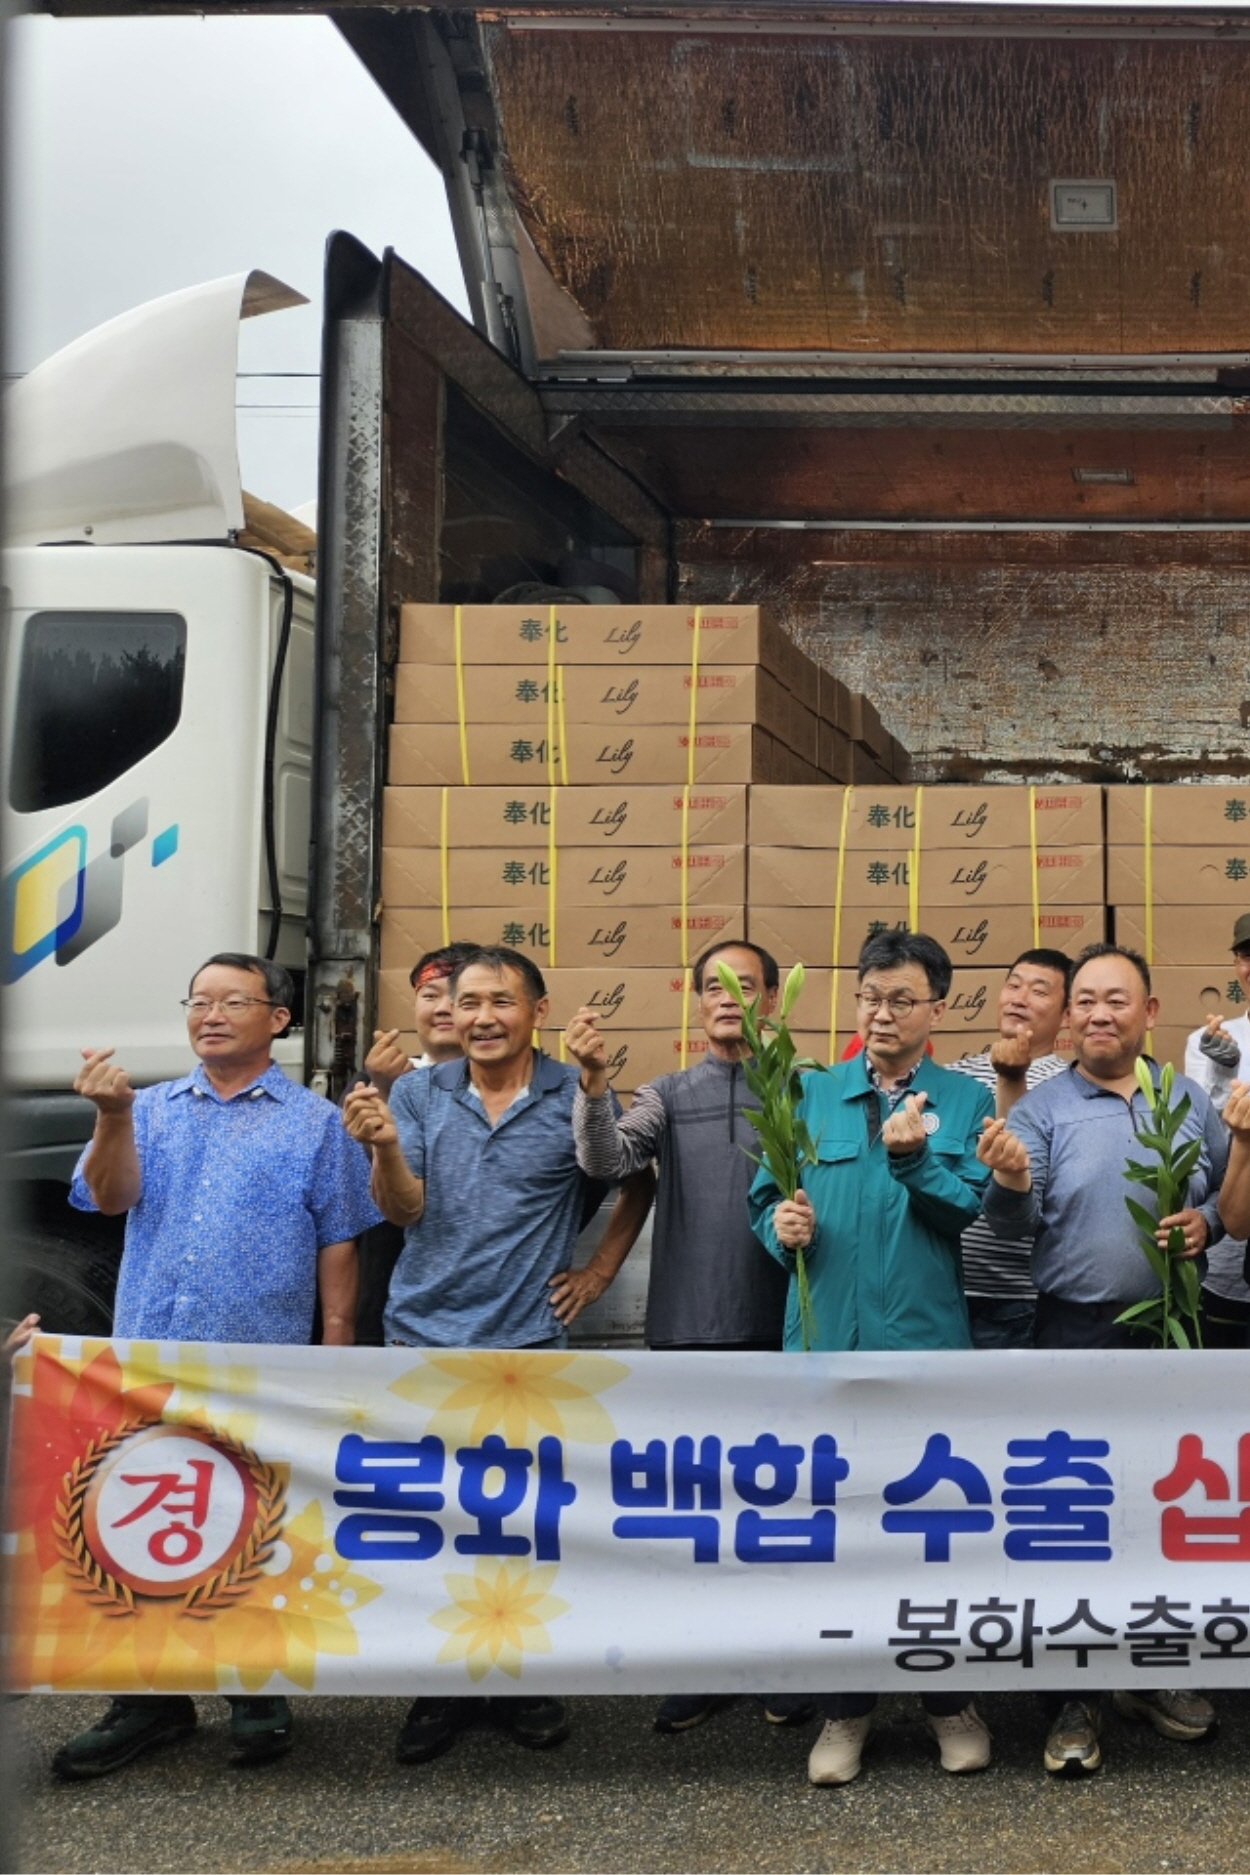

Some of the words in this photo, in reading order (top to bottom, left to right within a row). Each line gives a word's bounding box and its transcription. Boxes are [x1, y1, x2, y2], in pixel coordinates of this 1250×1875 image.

[519, 618, 568, 643] 奉化
[603, 620, 642, 655] Lily
[600, 678, 639, 715] Lily
[595, 738, 634, 774] Lily
[503, 800, 551, 825] 奉化
[589, 801, 628, 836] Lily
[867, 804, 915, 829] 奉化
[950, 802, 988, 838] Lily
[502, 860, 551, 886] 奉化
[588, 860, 627, 896] Lily
[951, 860, 988, 896] Lily
[502, 921, 551, 948] 奉化
[587, 921, 627, 957] Lily
[950, 919, 989, 955] Lily
[586, 982, 626, 1019] Lily
[949, 985, 987, 1022] Lily
[111, 1458, 215, 1566] 경
[333, 1433, 577, 1561] 봉화
[611, 1433, 850, 1563] 백합
[881, 1430, 1115, 1562] 수출
